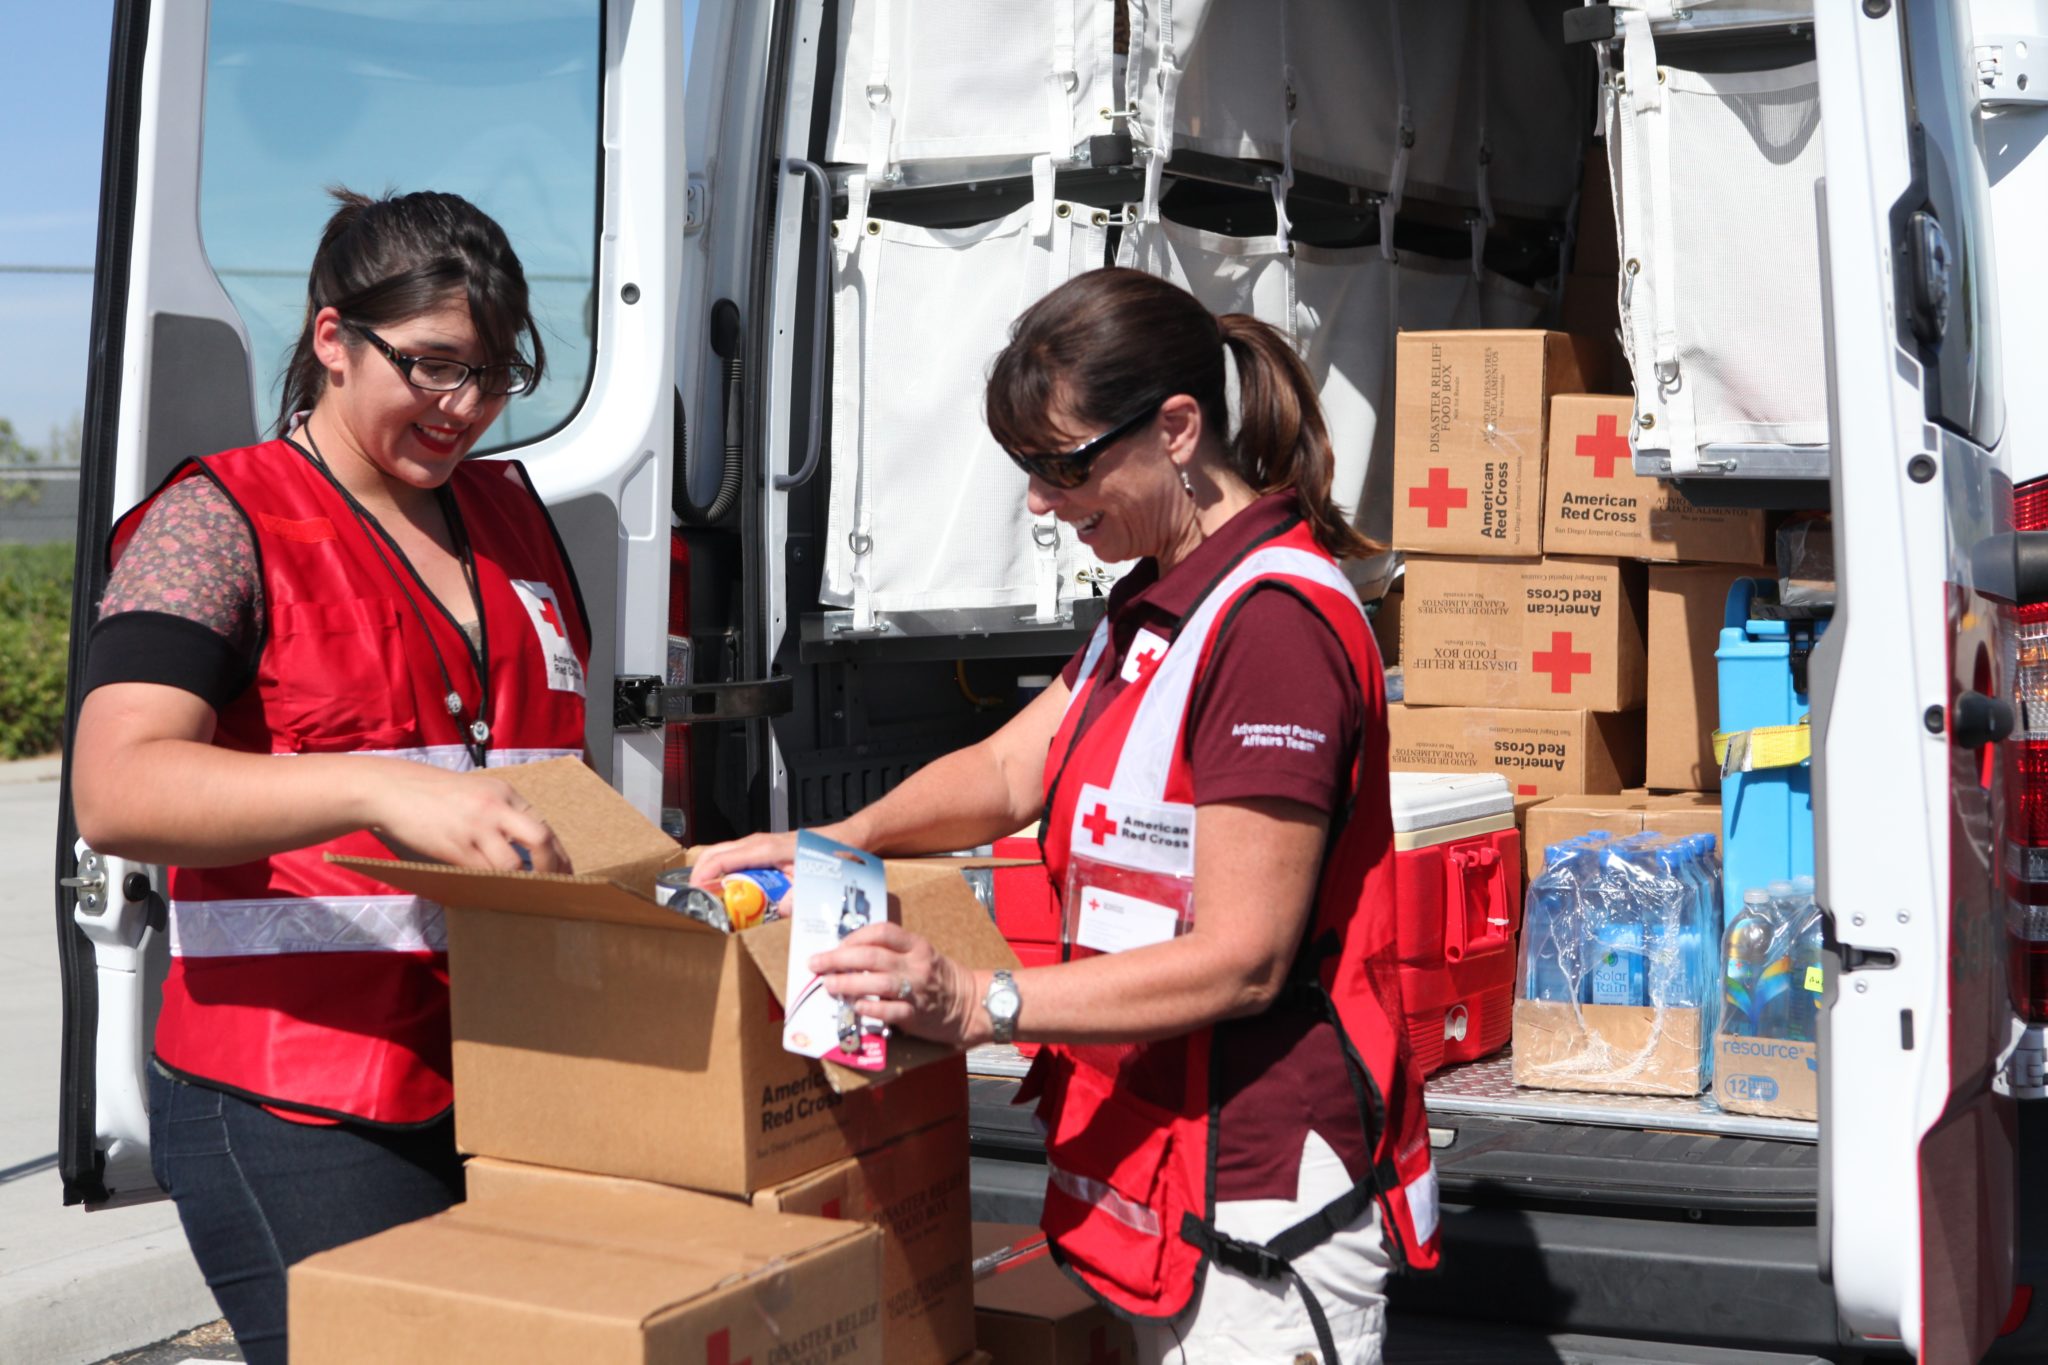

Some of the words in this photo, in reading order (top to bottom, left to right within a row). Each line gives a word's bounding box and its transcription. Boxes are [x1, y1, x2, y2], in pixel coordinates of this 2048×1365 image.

[1431, 342, 1442, 387] RELIEF
[1441, 364, 1452, 392] BOX
[1440, 396, 1451, 432] FOOD
[1429, 391, 1441, 453] DISASTER
[1495, 462, 1509, 506] Cross
[1480, 462, 1494, 538] American
[1562, 491, 1637, 508] American
[1560, 506, 1590, 520] Red
[1592, 508, 1637, 523] Cross
[1494, 509, 1507, 539] Red
[1526, 588, 1570, 602] Cross
[1572, 589, 1602, 602] Red
[1418, 606, 1465, 615] DESASTRES
[1422, 599, 1470, 607] ALIMENTOS
[1527, 603, 1601, 617] American
[1468, 607, 1478, 615] DE
[1480, 607, 1510, 615] ALIVIO
[1433, 647, 1459, 659] BOX
[1463, 648, 1497, 660] FOOD
[1413, 658, 1455, 669] RELIEF
[1459, 659, 1518, 671] DISASTER
[1231, 722, 1292, 737] Advanced
[1292, 724, 1327, 743] Public
[1241, 734, 1284, 748] Affairs
[1285, 735, 1316, 752] Team
[1494, 741, 1535, 756] Cross
[1537, 743, 1566, 757] Red
[1444, 750, 1453, 758] DE
[1455, 751, 1475, 760] CAJA
[1450, 758, 1478, 767] ALIVIO
[1494, 756, 1565, 771] American
[1123, 815, 1190, 836] American
[1121, 827, 1147, 842] Red
[1149, 833, 1190, 849] Cross
[1594, 969, 1627, 981] Solar
[1595, 981, 1627, 993] Rain
[1723, 1040, 1799, 1060] resource
[1728, 1078, 1748, 1094] 12
[761, 1102, 794, 1134] Red
[835, 1300, 880, 1337] RELIEF
